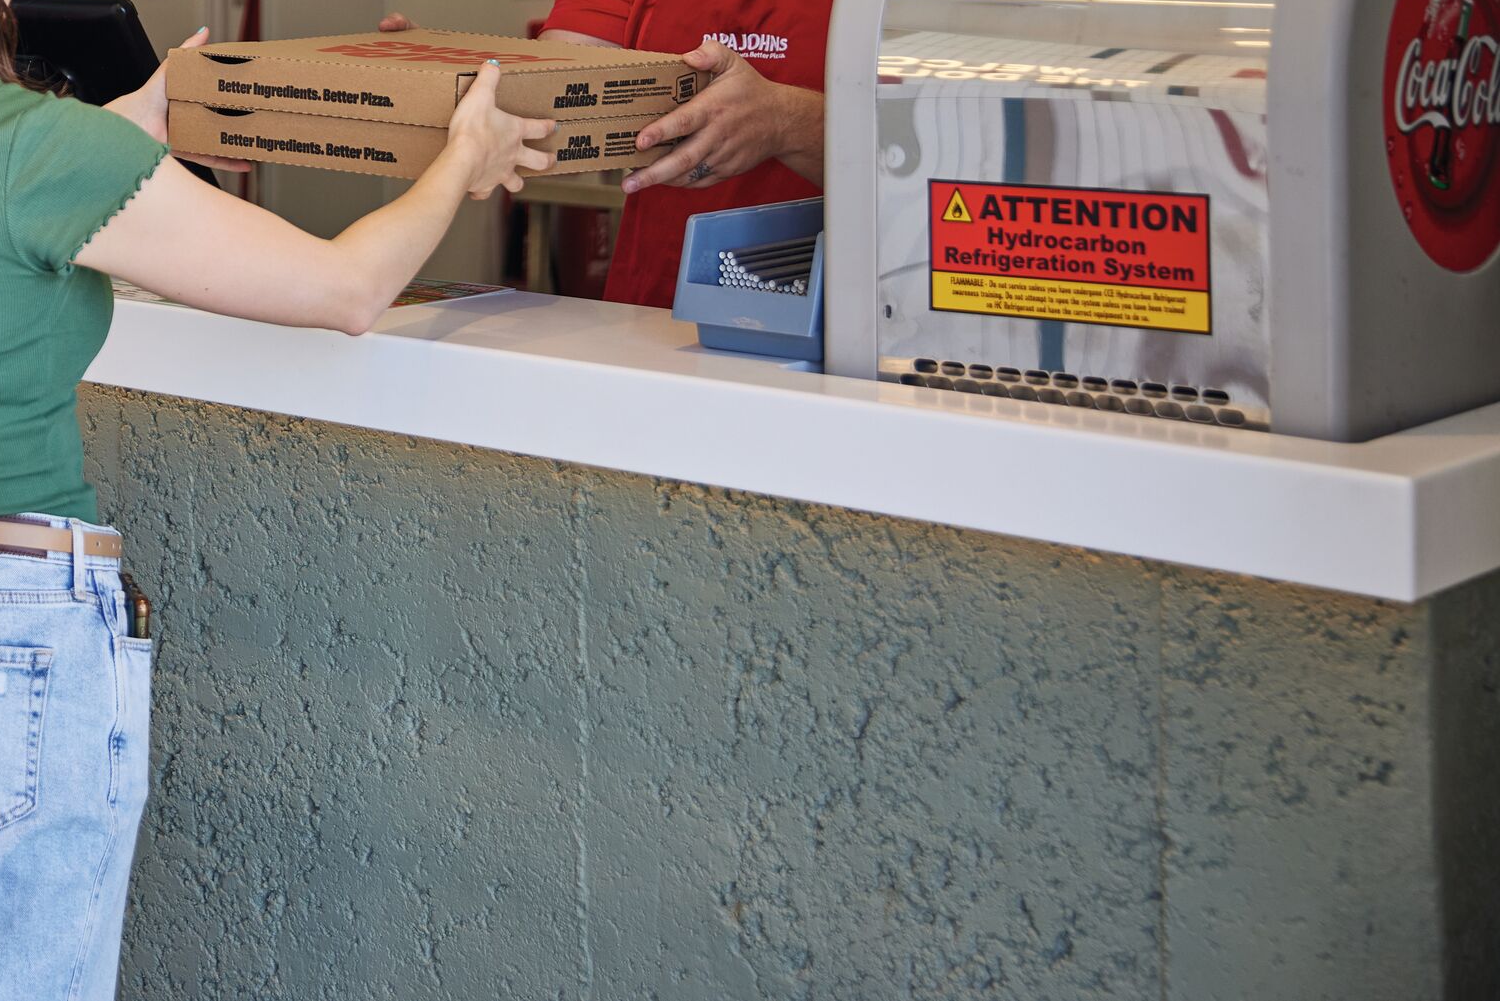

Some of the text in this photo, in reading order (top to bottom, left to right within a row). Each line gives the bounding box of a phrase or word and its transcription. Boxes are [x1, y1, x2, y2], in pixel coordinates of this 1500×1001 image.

[738, 33, 788, 52] JOHNS
[749, 51, 770, 59] Better
[218, 79, 394, 107] Better Ingredients. Better Pizza.
[565, 83, 589, 95] PAPA
[554, 94, 598, 109] REWARDS
[220, 132, 397, 163] Better Ingredients. Better Pizza.
[568, 135, 591, 148] PAPA
[557, 146, 600, 161] REWARDS
[979, 194, 1198, 233] ATTENTION
[987, 226, 1147, 255] Hydrocarbon
[944, 246, 1194, 282] Refrigeration System
[950, 276, 983, 287] FLAMMABLE
[989, 280, 996, 288] Do
[998, 281, 1007, 289] not
[1009, 282, 1027, 290] service
[1047, 285, 1057, 293] you
[1058, 285, 1071, 294] have
[1116, 289, 1151, 300] Hydrocarbon
[1153, 292, 1187, 304] Refrigerant
[1004, 301, 1034, 312] Refrigerant
[1036, 305, 1046, 313] and
[1047, 306, 1060, 314] have
[1073, 309, 1092, 317] correct
[1093, 310, 1123, 320] equipment
[1005, 291, 1013, 299] Do
[1015, 292, 1023, 300] not
[1025, 294, 1046, 303] attempt
[1048, 295, 1054, 303] to
[1070, 297, 1079, 305] the
[1081, 298, 1100, 308] system
[1121, 302, 1131, 311] you
[1133, 302, 1146, 311] have
[1148, 304, 1162, 312] been
[1163, 305, 1185, 314] trained
